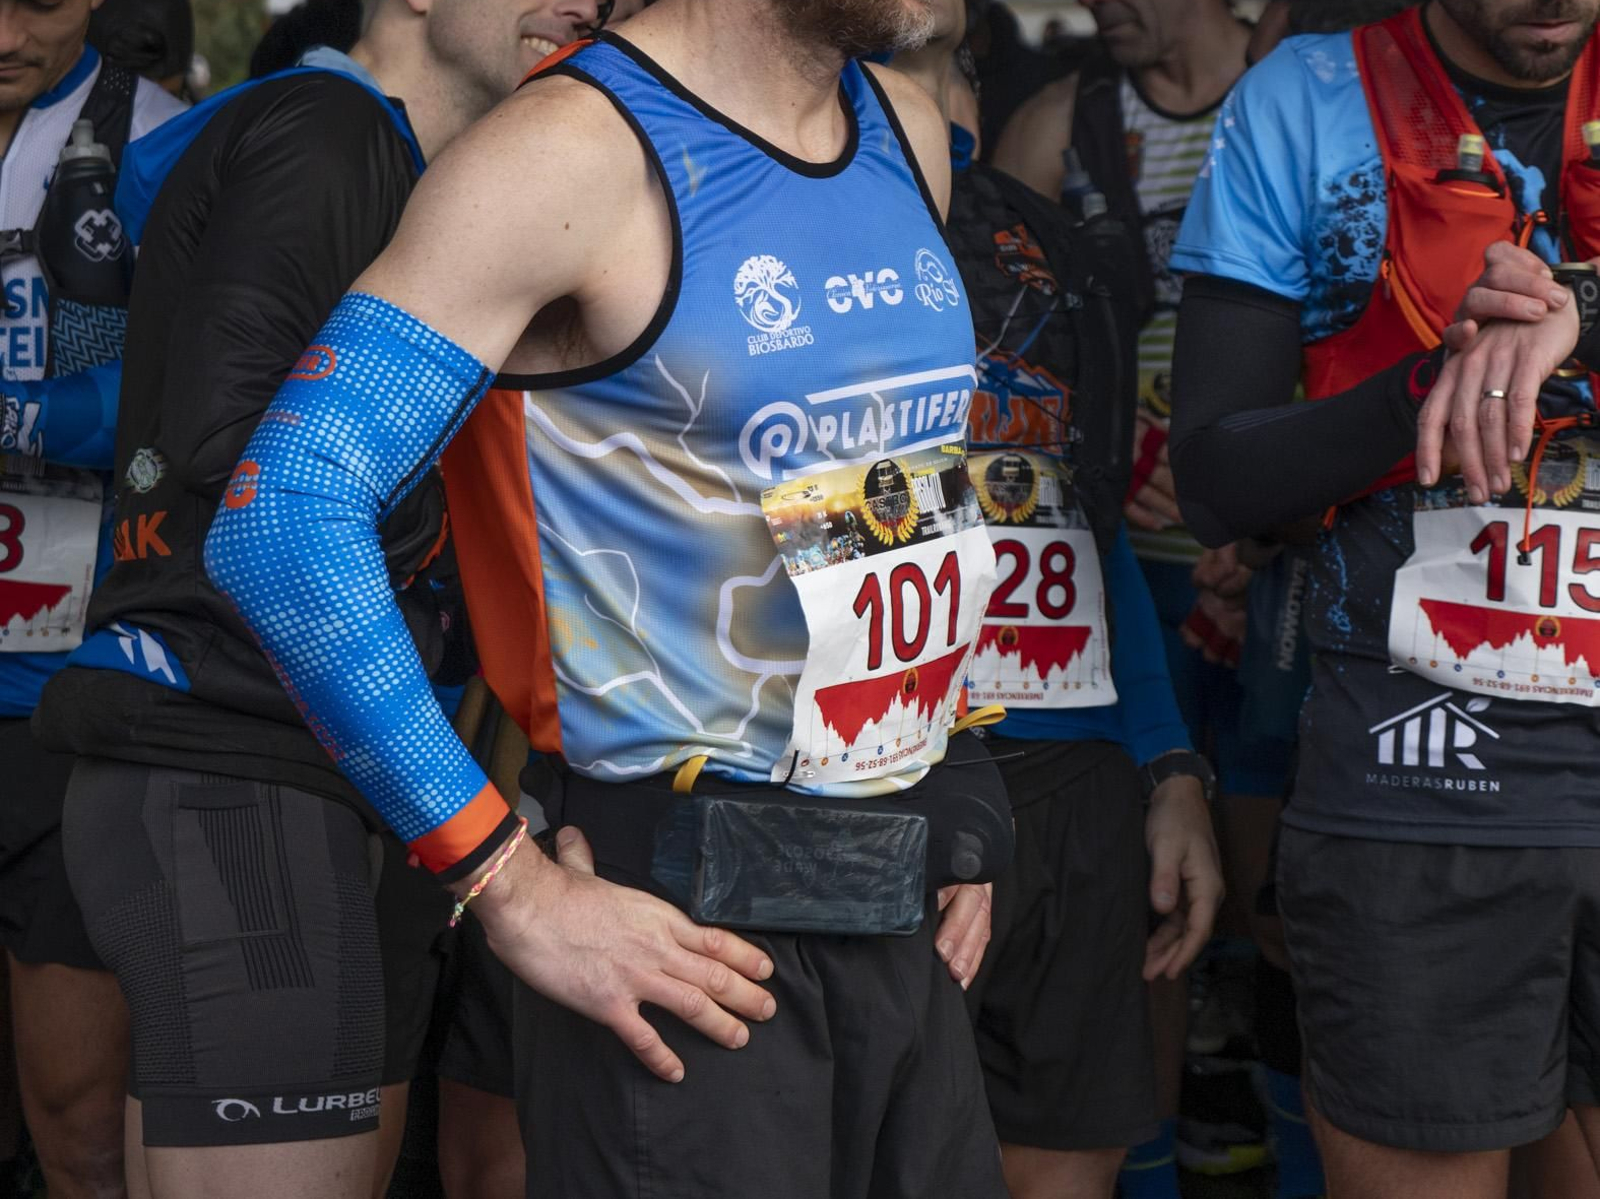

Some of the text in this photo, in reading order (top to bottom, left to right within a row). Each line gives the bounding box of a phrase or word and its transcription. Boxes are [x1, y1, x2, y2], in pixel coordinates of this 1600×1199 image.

[748, 333, 815, 357] BIOSBARDO
[816, 389, 970, 452] PLASTIFER
[1469, 520, 1600, 613] 115
[852, 550, 962, 671] 101
